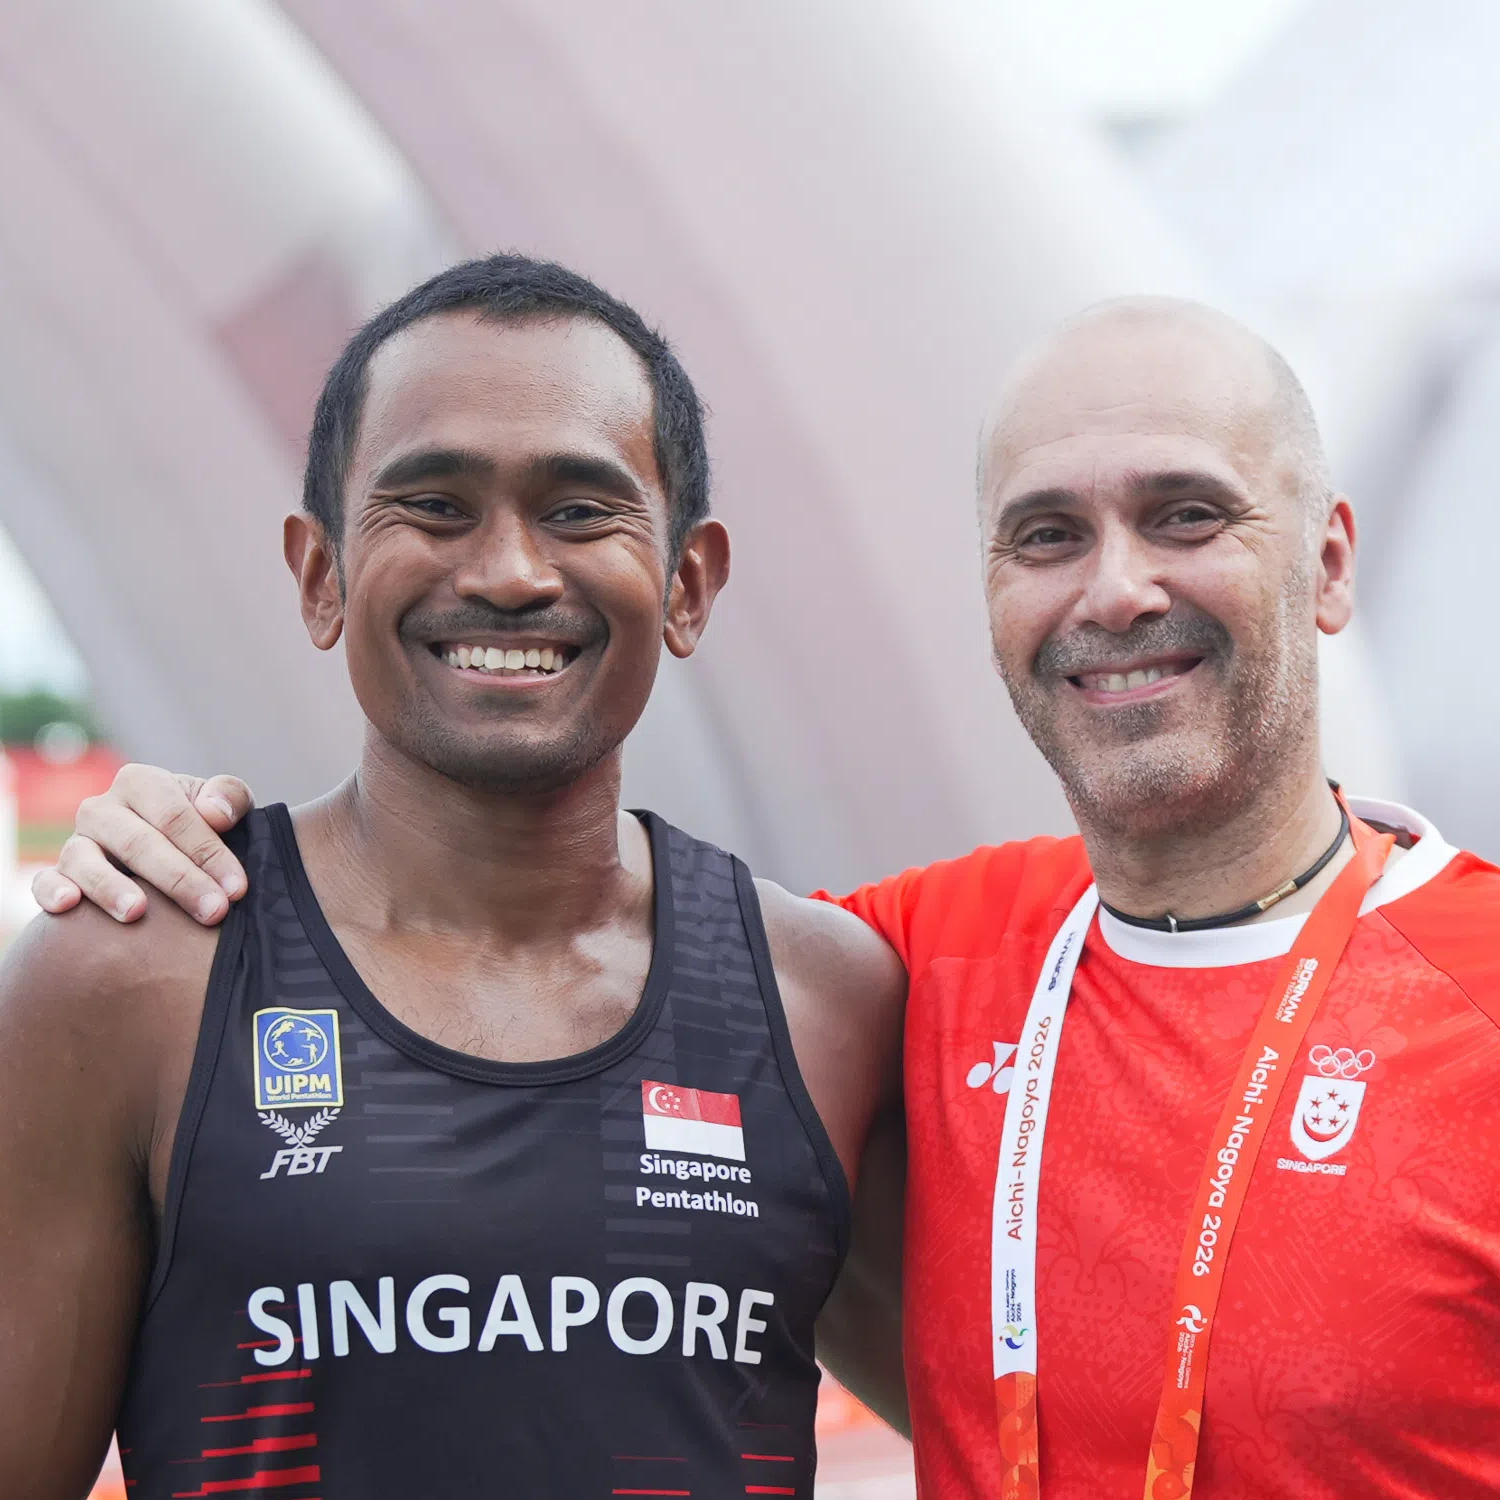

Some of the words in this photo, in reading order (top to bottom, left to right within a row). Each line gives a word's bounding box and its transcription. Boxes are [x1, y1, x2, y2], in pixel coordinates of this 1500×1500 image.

[1280, 957, 1319, 1023] BORNAN
[264, 1073, 332, 1095] UIPM
[1006, 1077, 1040, 1241] Aichi-Nagoya
[1027, 1015, 1052, 1072] 2026
[1208, 1045, 1280, 1209] Aichi-Nagoya
[260, 1145, 344, 1180] FBT
[640, 1153, 752, 1184] Singapore
[1276, 1157, 1348, 1177] SINGAPORE
[635, 1186, 759, 1218] Pentathlon
[1192, 1213, 1222, 1277] 2026
[246, 1273, 775, 1367] SINGAPORE
